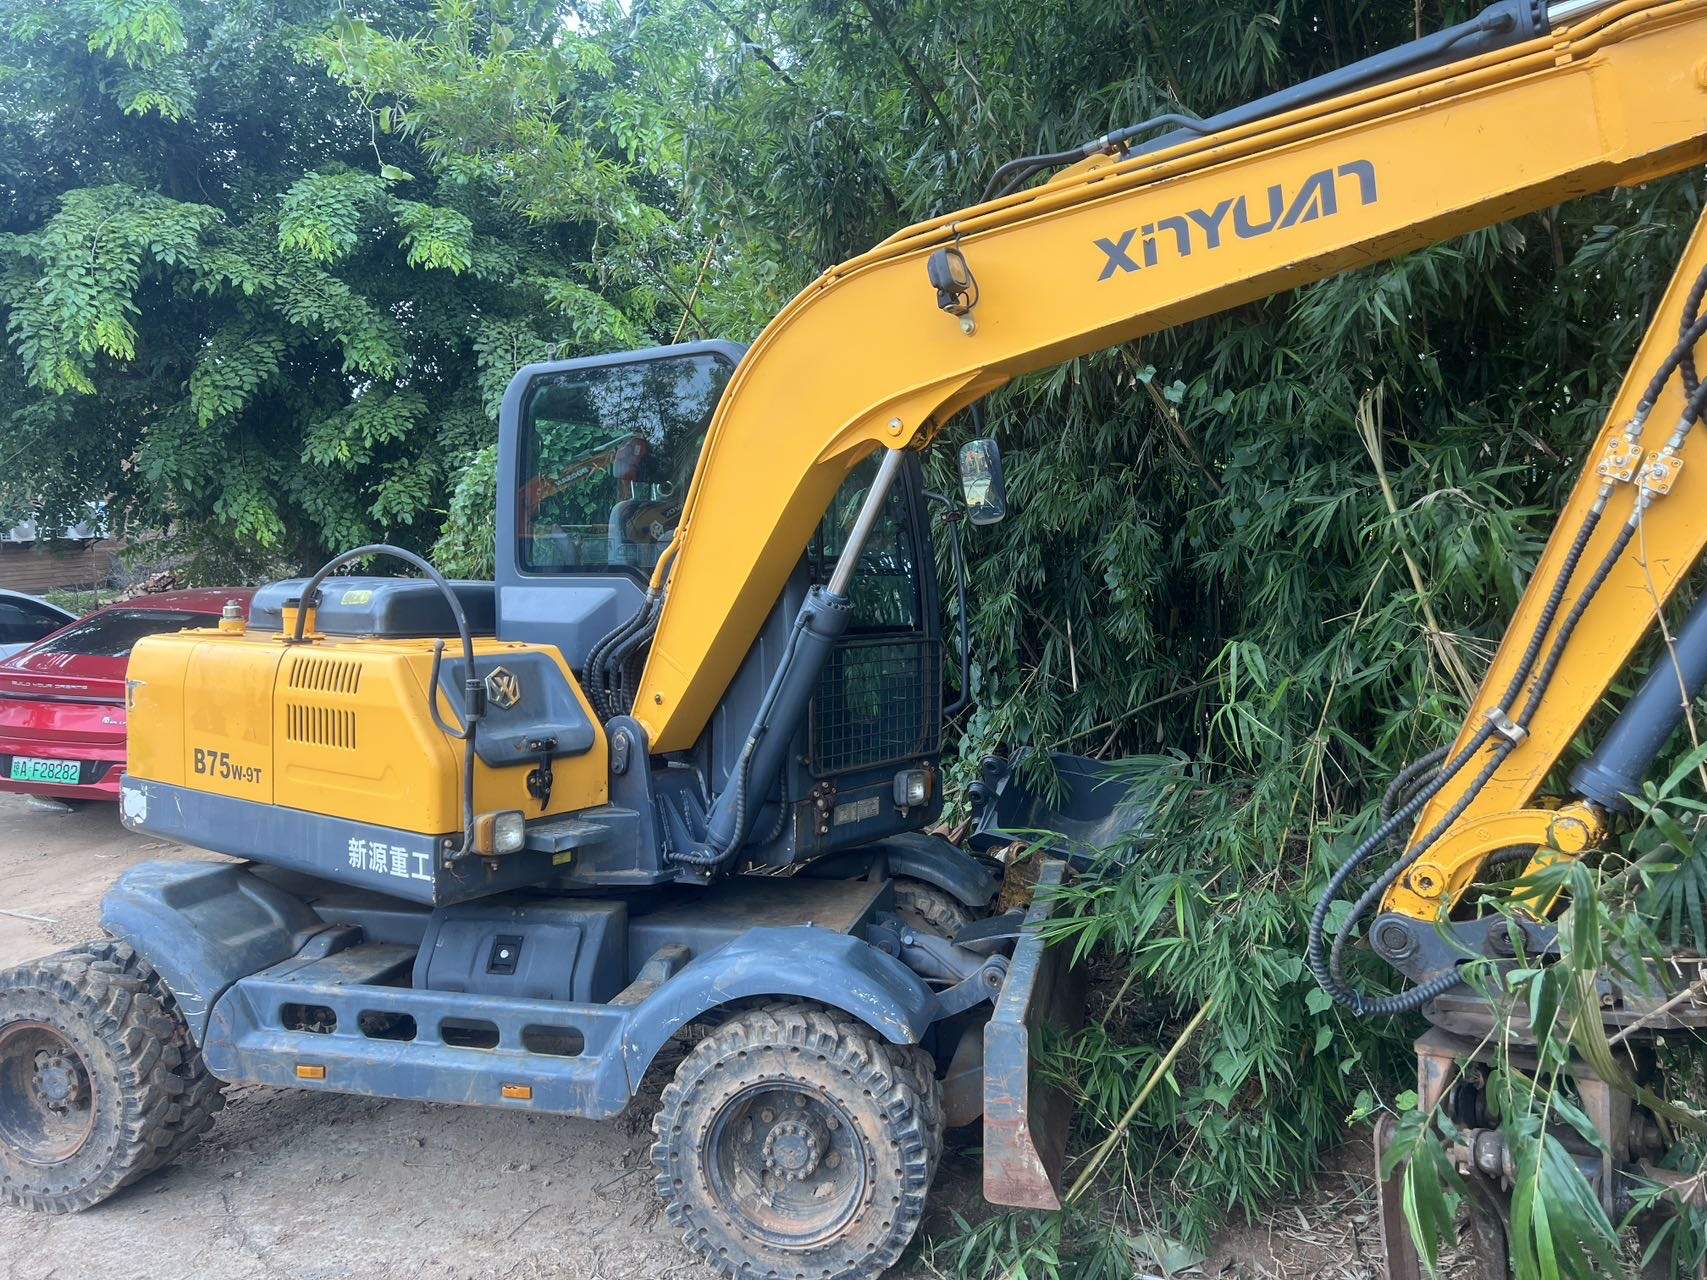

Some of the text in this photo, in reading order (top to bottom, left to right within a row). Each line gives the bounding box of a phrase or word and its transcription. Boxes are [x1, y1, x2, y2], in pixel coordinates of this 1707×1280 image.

[194, 748, 262, 783] B75W-9T
[348, 837, 432, 881] 新源重工
